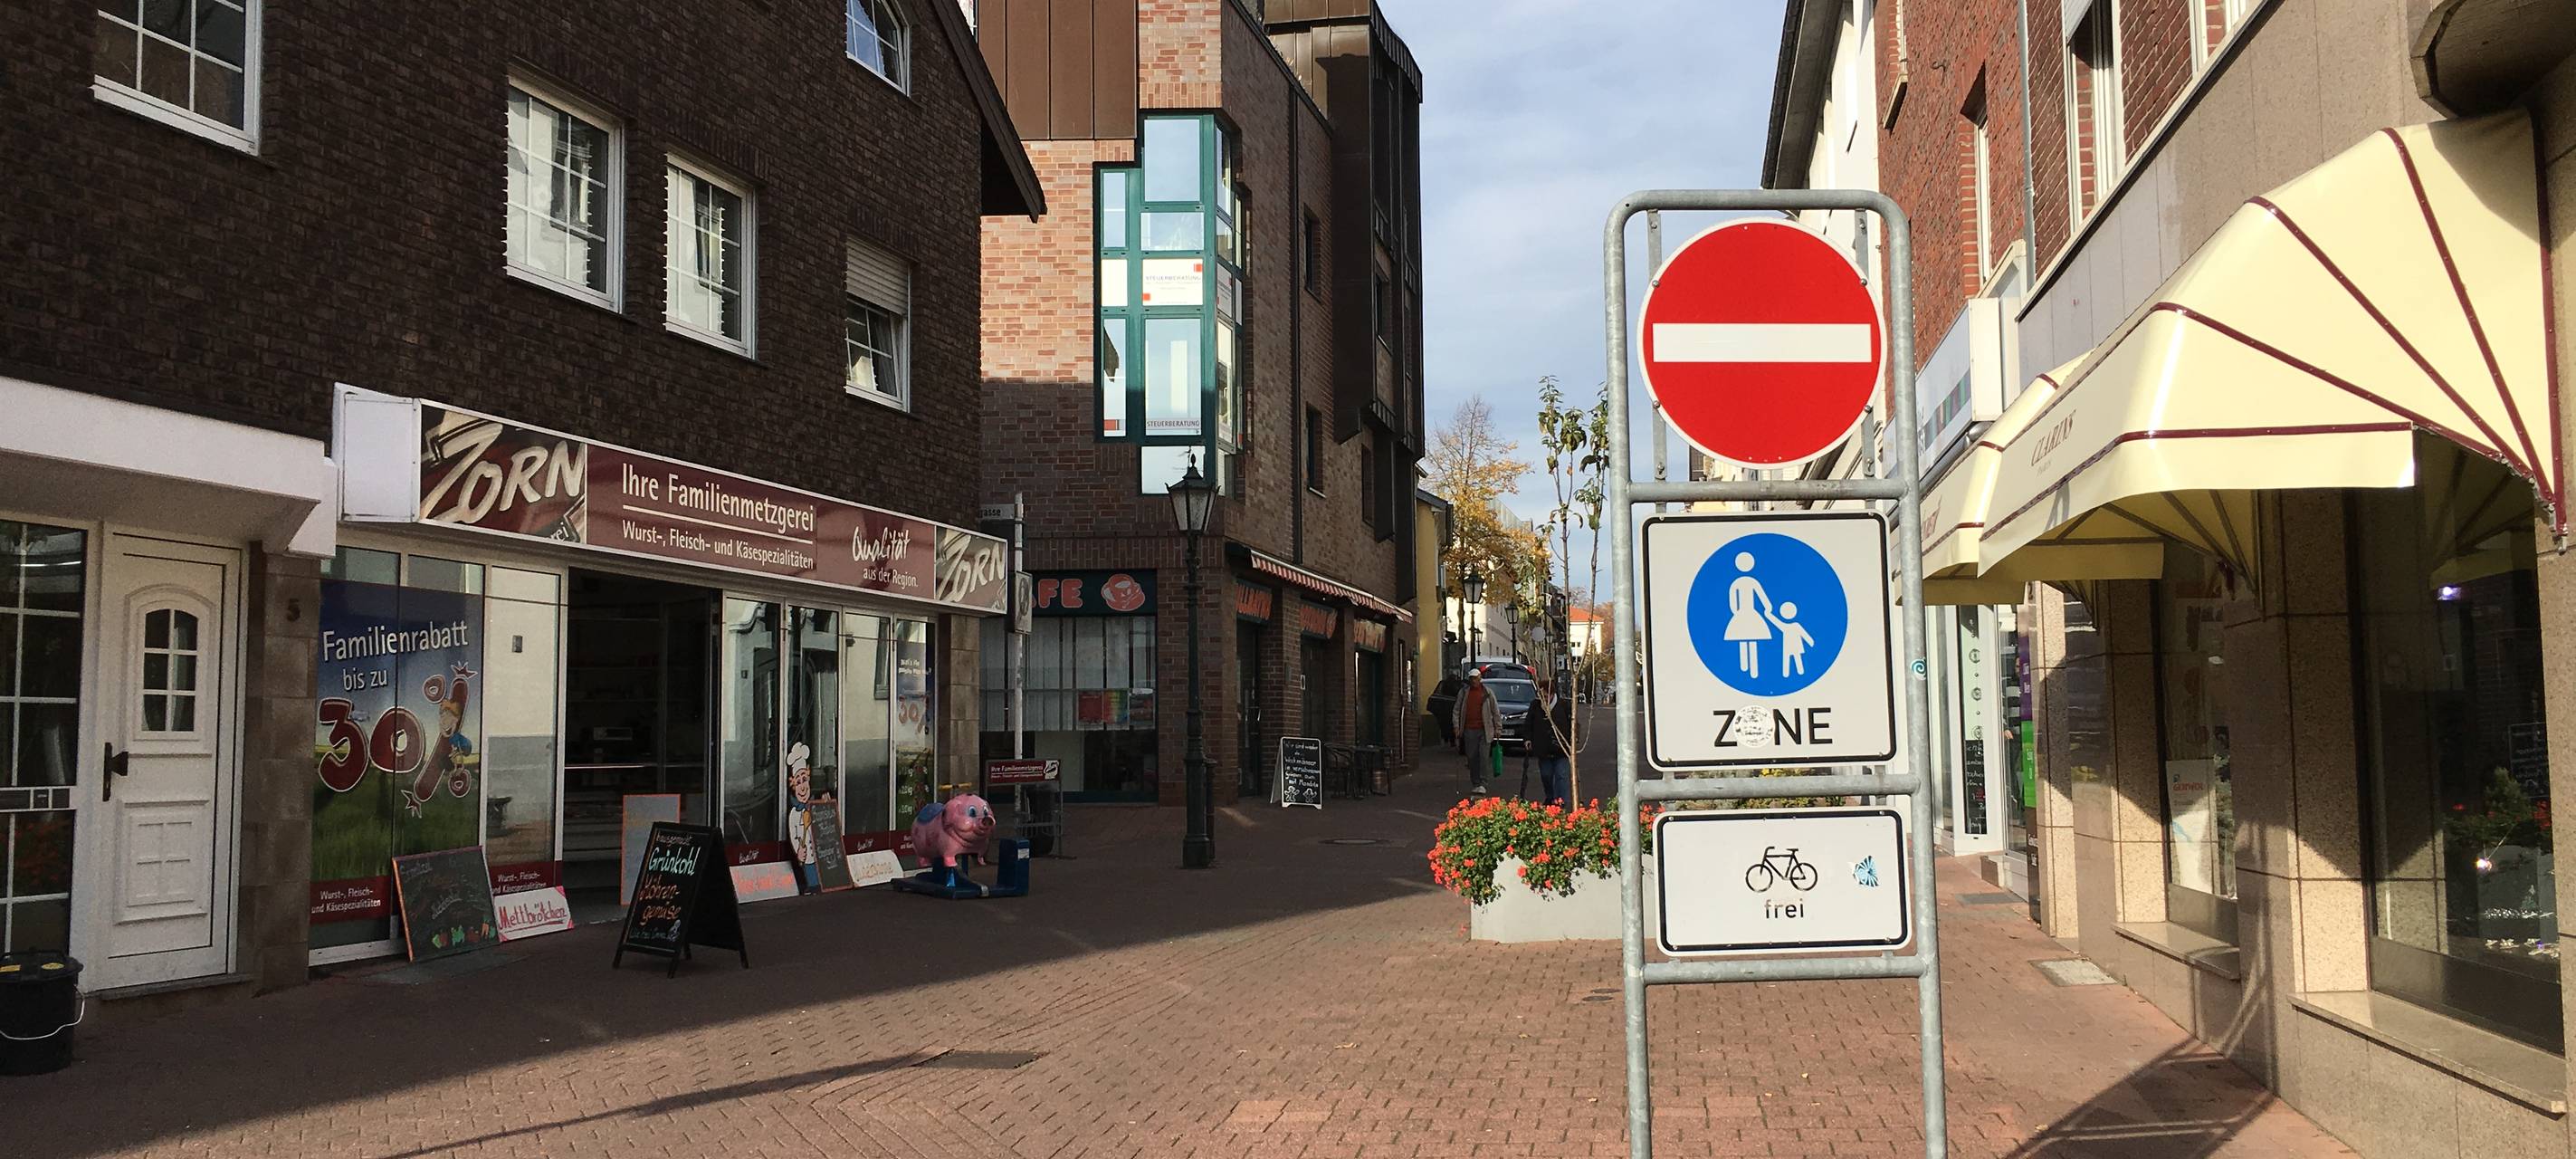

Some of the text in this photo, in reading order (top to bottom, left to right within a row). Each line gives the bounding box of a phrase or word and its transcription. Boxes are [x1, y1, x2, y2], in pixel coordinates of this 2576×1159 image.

[2031, 408, 2076, 466] CLARINS
[420, 422, 586, 524] ZORN
[622, 463, 814, 534] Ihre Familienmetzgerei
[623, 519, 814, 570] Wurst-, Fleisch- und Käsespezialitäten
[852, 526, 911, 562] Qualität
[863, 570, 919, 589] aus der Region.
[935, 533, 1007, 604] ZORN
[286, 598, 301, 623] 5
[1032, 578, 1084, 608] FE
[322, 620, 469, 662] Familienrabatt
[343, 667, 388, 691] bis zu
[1713, 707, 1833, 747] ZNE
[648, 847, 701, 876] Grünkohl
[498, 900, 567, 930] Mettbrötchen
[1764, 898, 1804, 919] frei
